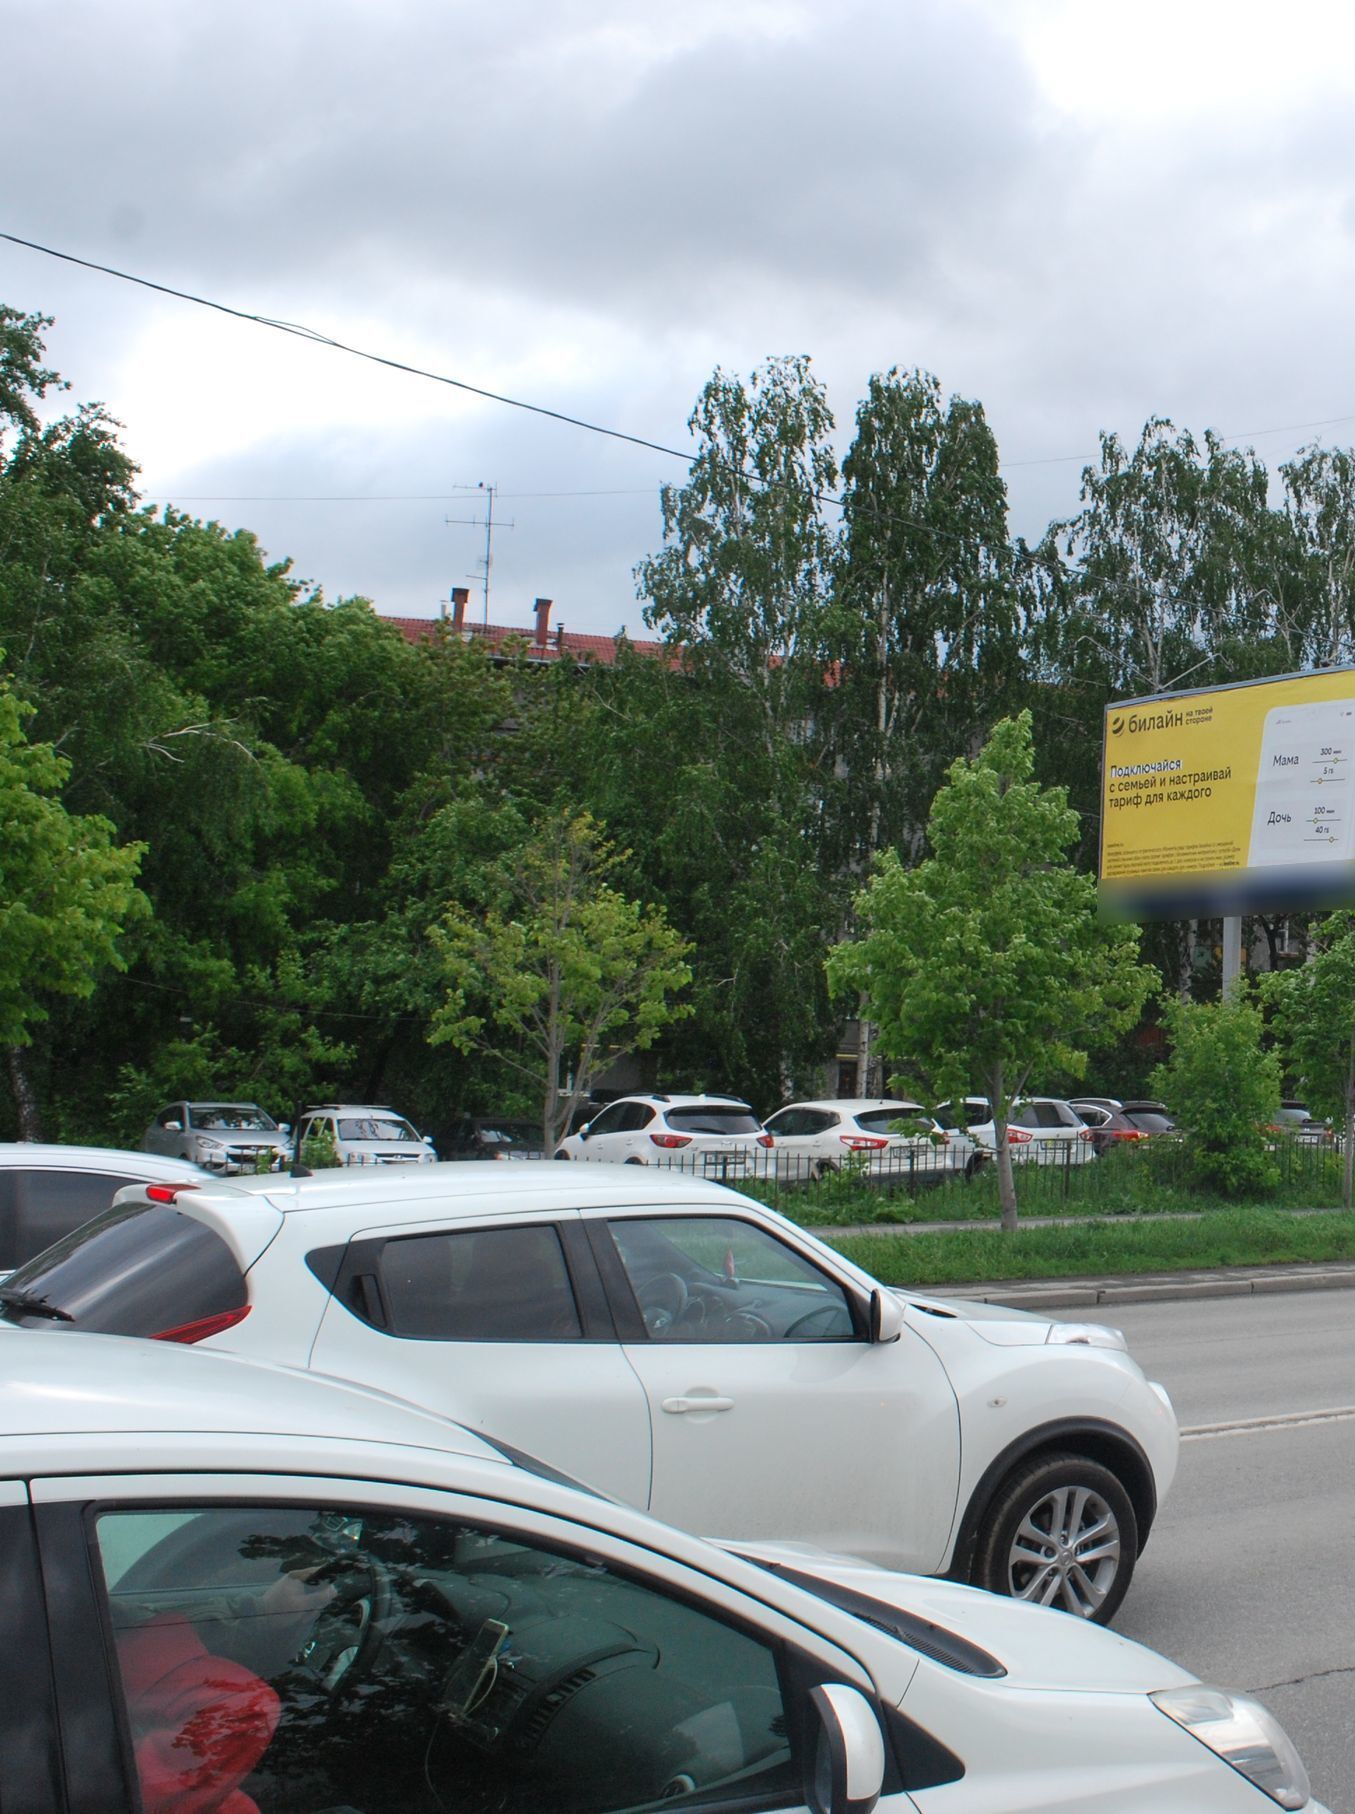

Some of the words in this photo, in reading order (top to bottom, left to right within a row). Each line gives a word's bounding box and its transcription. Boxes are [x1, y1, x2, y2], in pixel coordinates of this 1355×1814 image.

[1128, 710, 1183, 733] билайн
[1110, 759, 1182, 778] Подключайся
[1272, 755, 1299, 766] Мама
[1109, 783, 1115, 793] с
[1117, 776, 1157, 792] семьей
[1159, 777, 1166, 786] и
[1168, 767, 1232, 787] настраивай
[1109, 792, 1142, 811] тариф
[1144, 792, 1164, 806] для
[1166, 786, 1212, 801] каждого
[1267, 811, 1292, 825] Дочь
